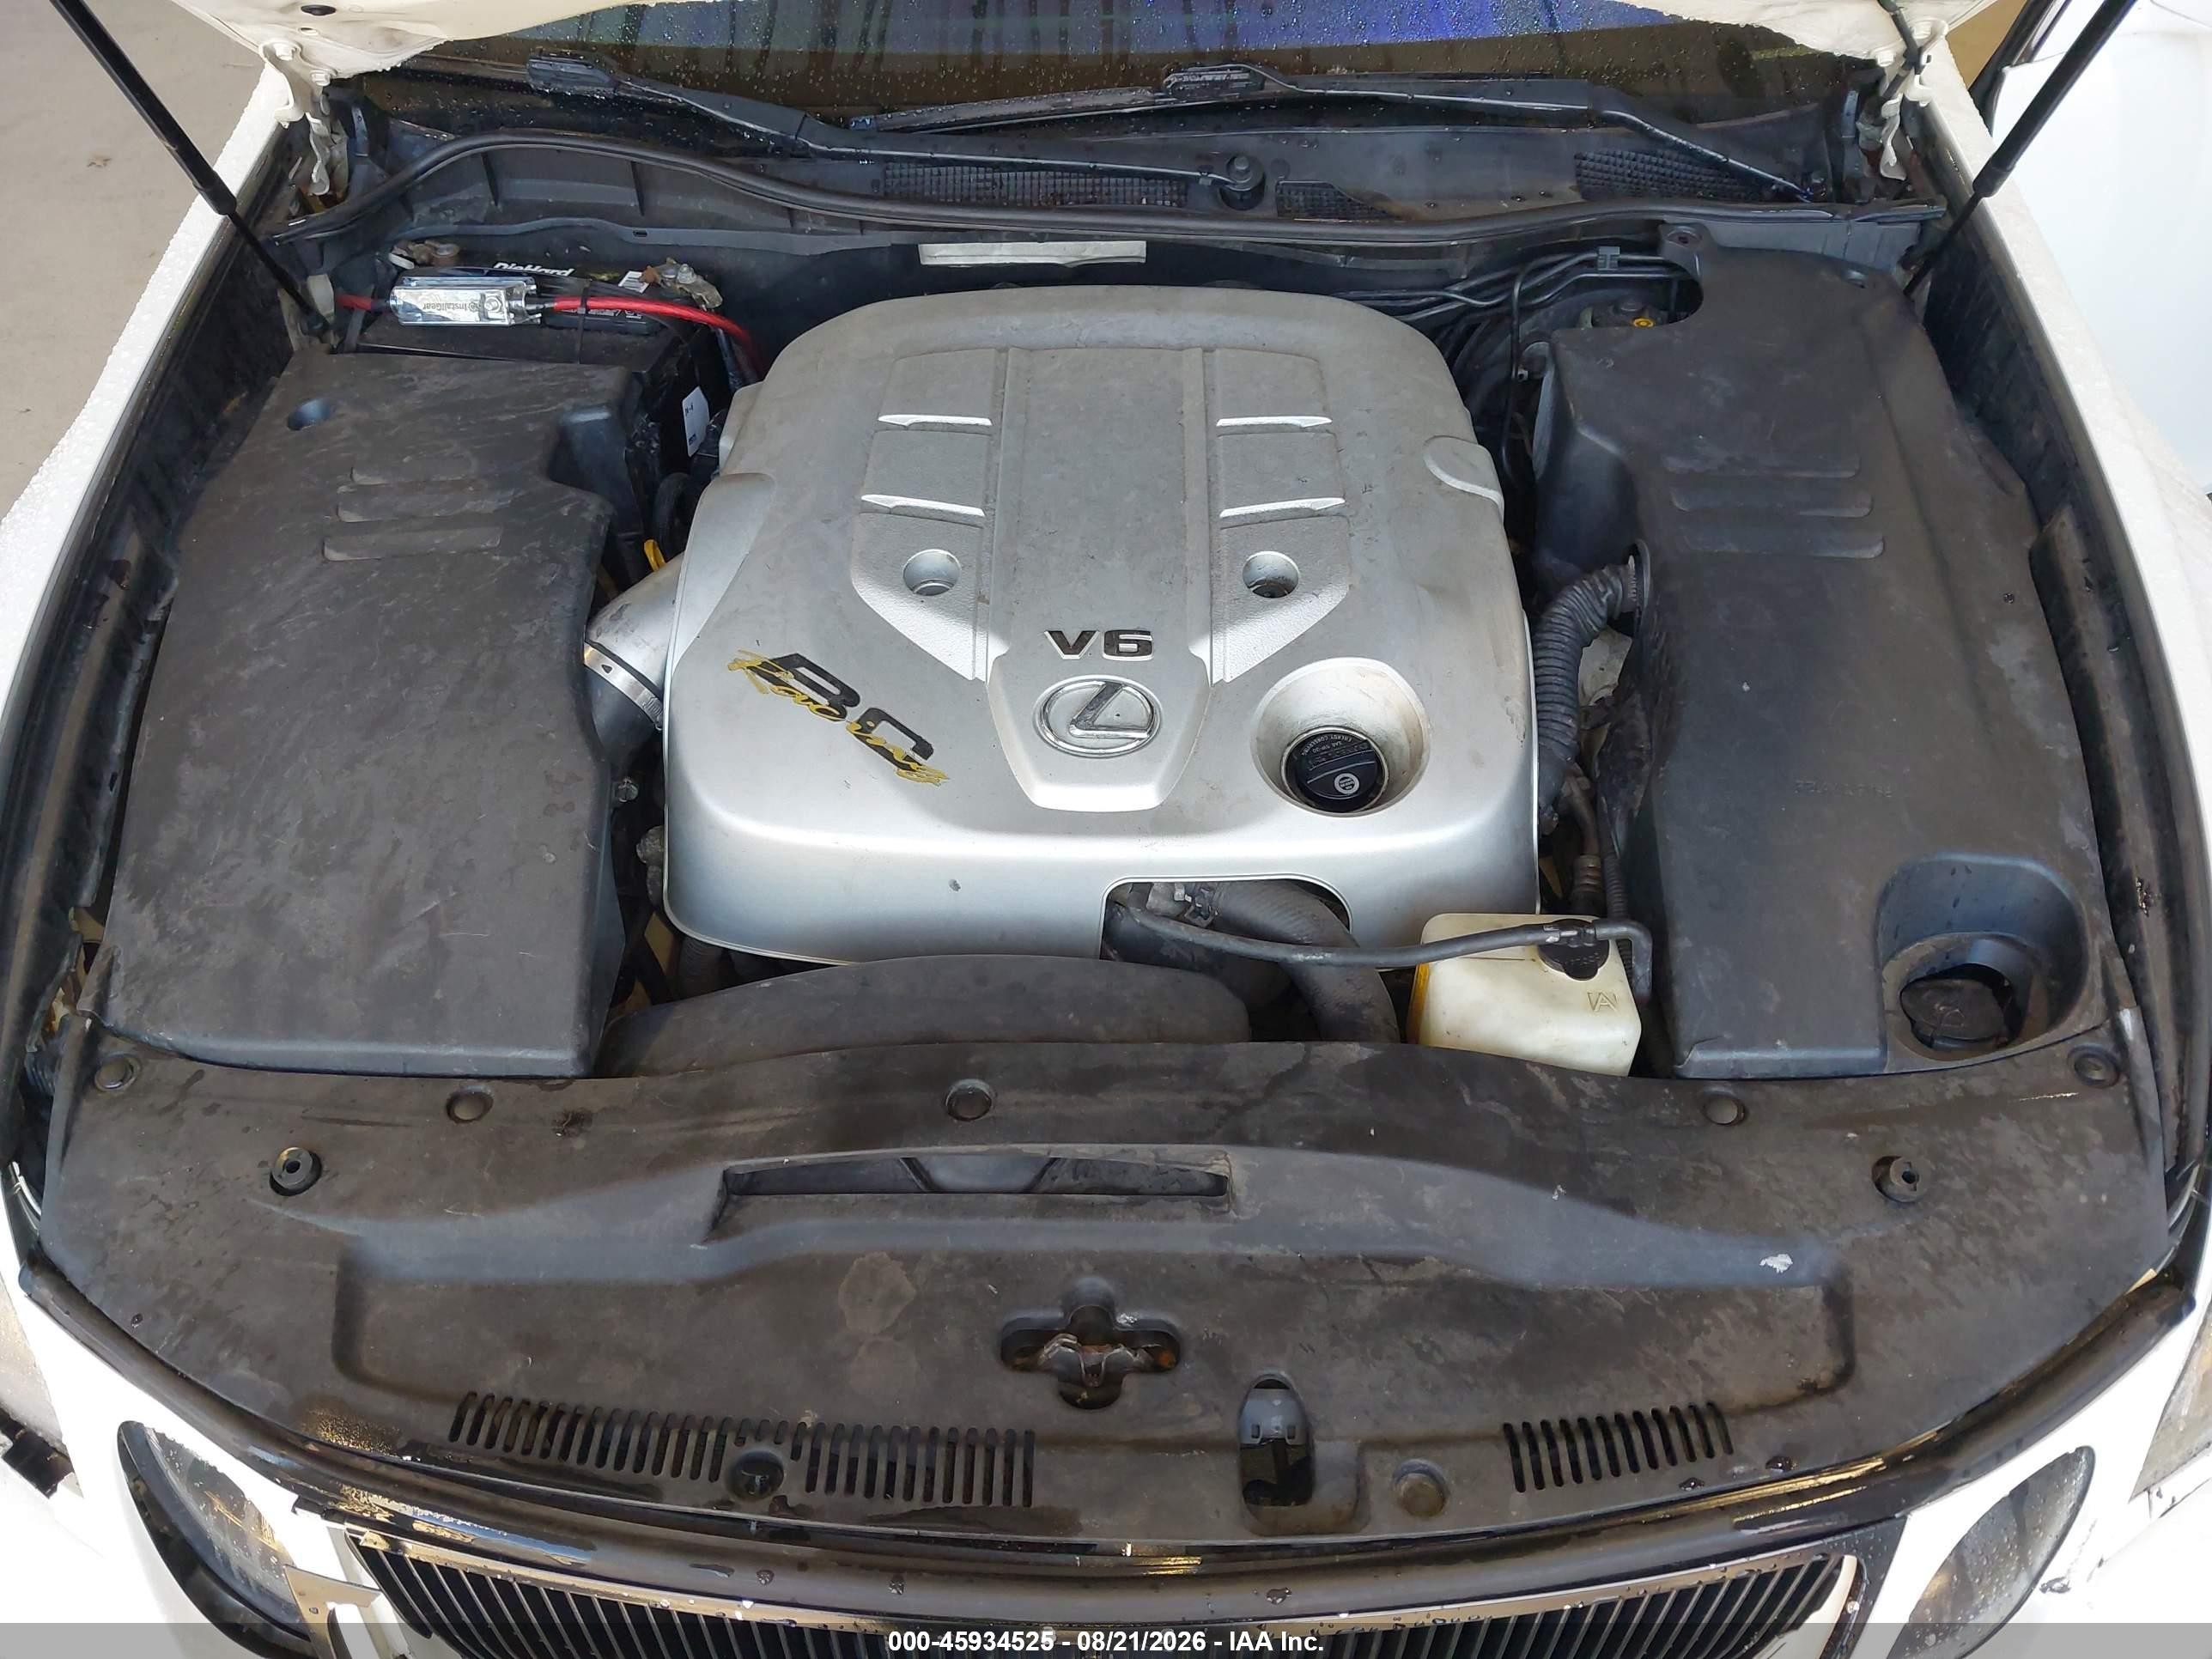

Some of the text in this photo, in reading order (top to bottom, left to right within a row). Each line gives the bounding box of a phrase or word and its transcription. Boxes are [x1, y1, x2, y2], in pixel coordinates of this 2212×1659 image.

[494, 262, 574, 276] DieHard
[422, 302, 468, 311] InstallGear
[1044, 629, 1154, 661] V6
